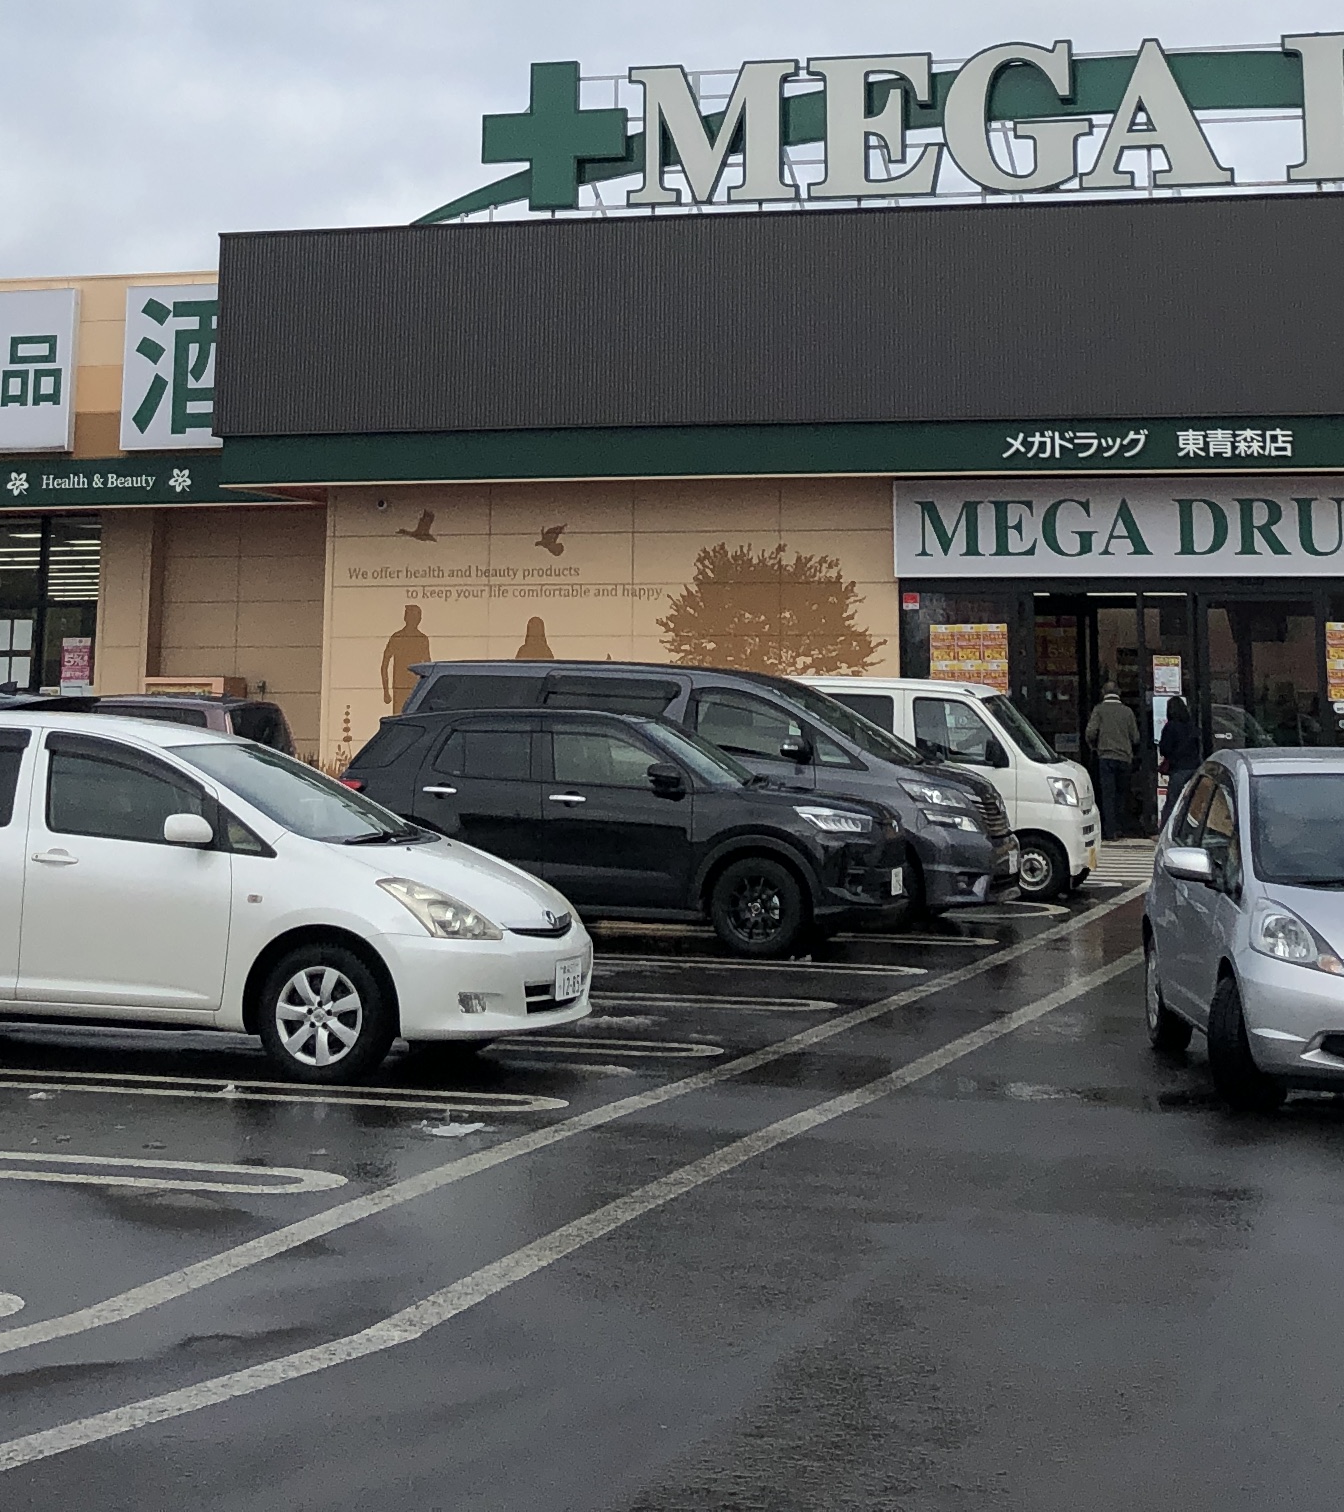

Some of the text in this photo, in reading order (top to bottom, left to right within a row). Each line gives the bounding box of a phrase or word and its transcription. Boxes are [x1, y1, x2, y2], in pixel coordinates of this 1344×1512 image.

[626, 37, 1235, 207] MEGA
[132, 297, 221, 435] 酒
[1001, 428, 1294, 459] メガドラッグ 東青森店
[41, 473, 156, 490] Health & Beauty
[915, 497, 1153, 557] MEGA
[348, 565, 580, 580] We offer health and beauty products
[406, 588, 419, 599] to
[422, 586, 452, 601] keep
[456, 588, 486, 601] your
[488, 585, 509, 597] life
[512, 584, 590, 598] comfortable
[593, 584, 619, 597] and
